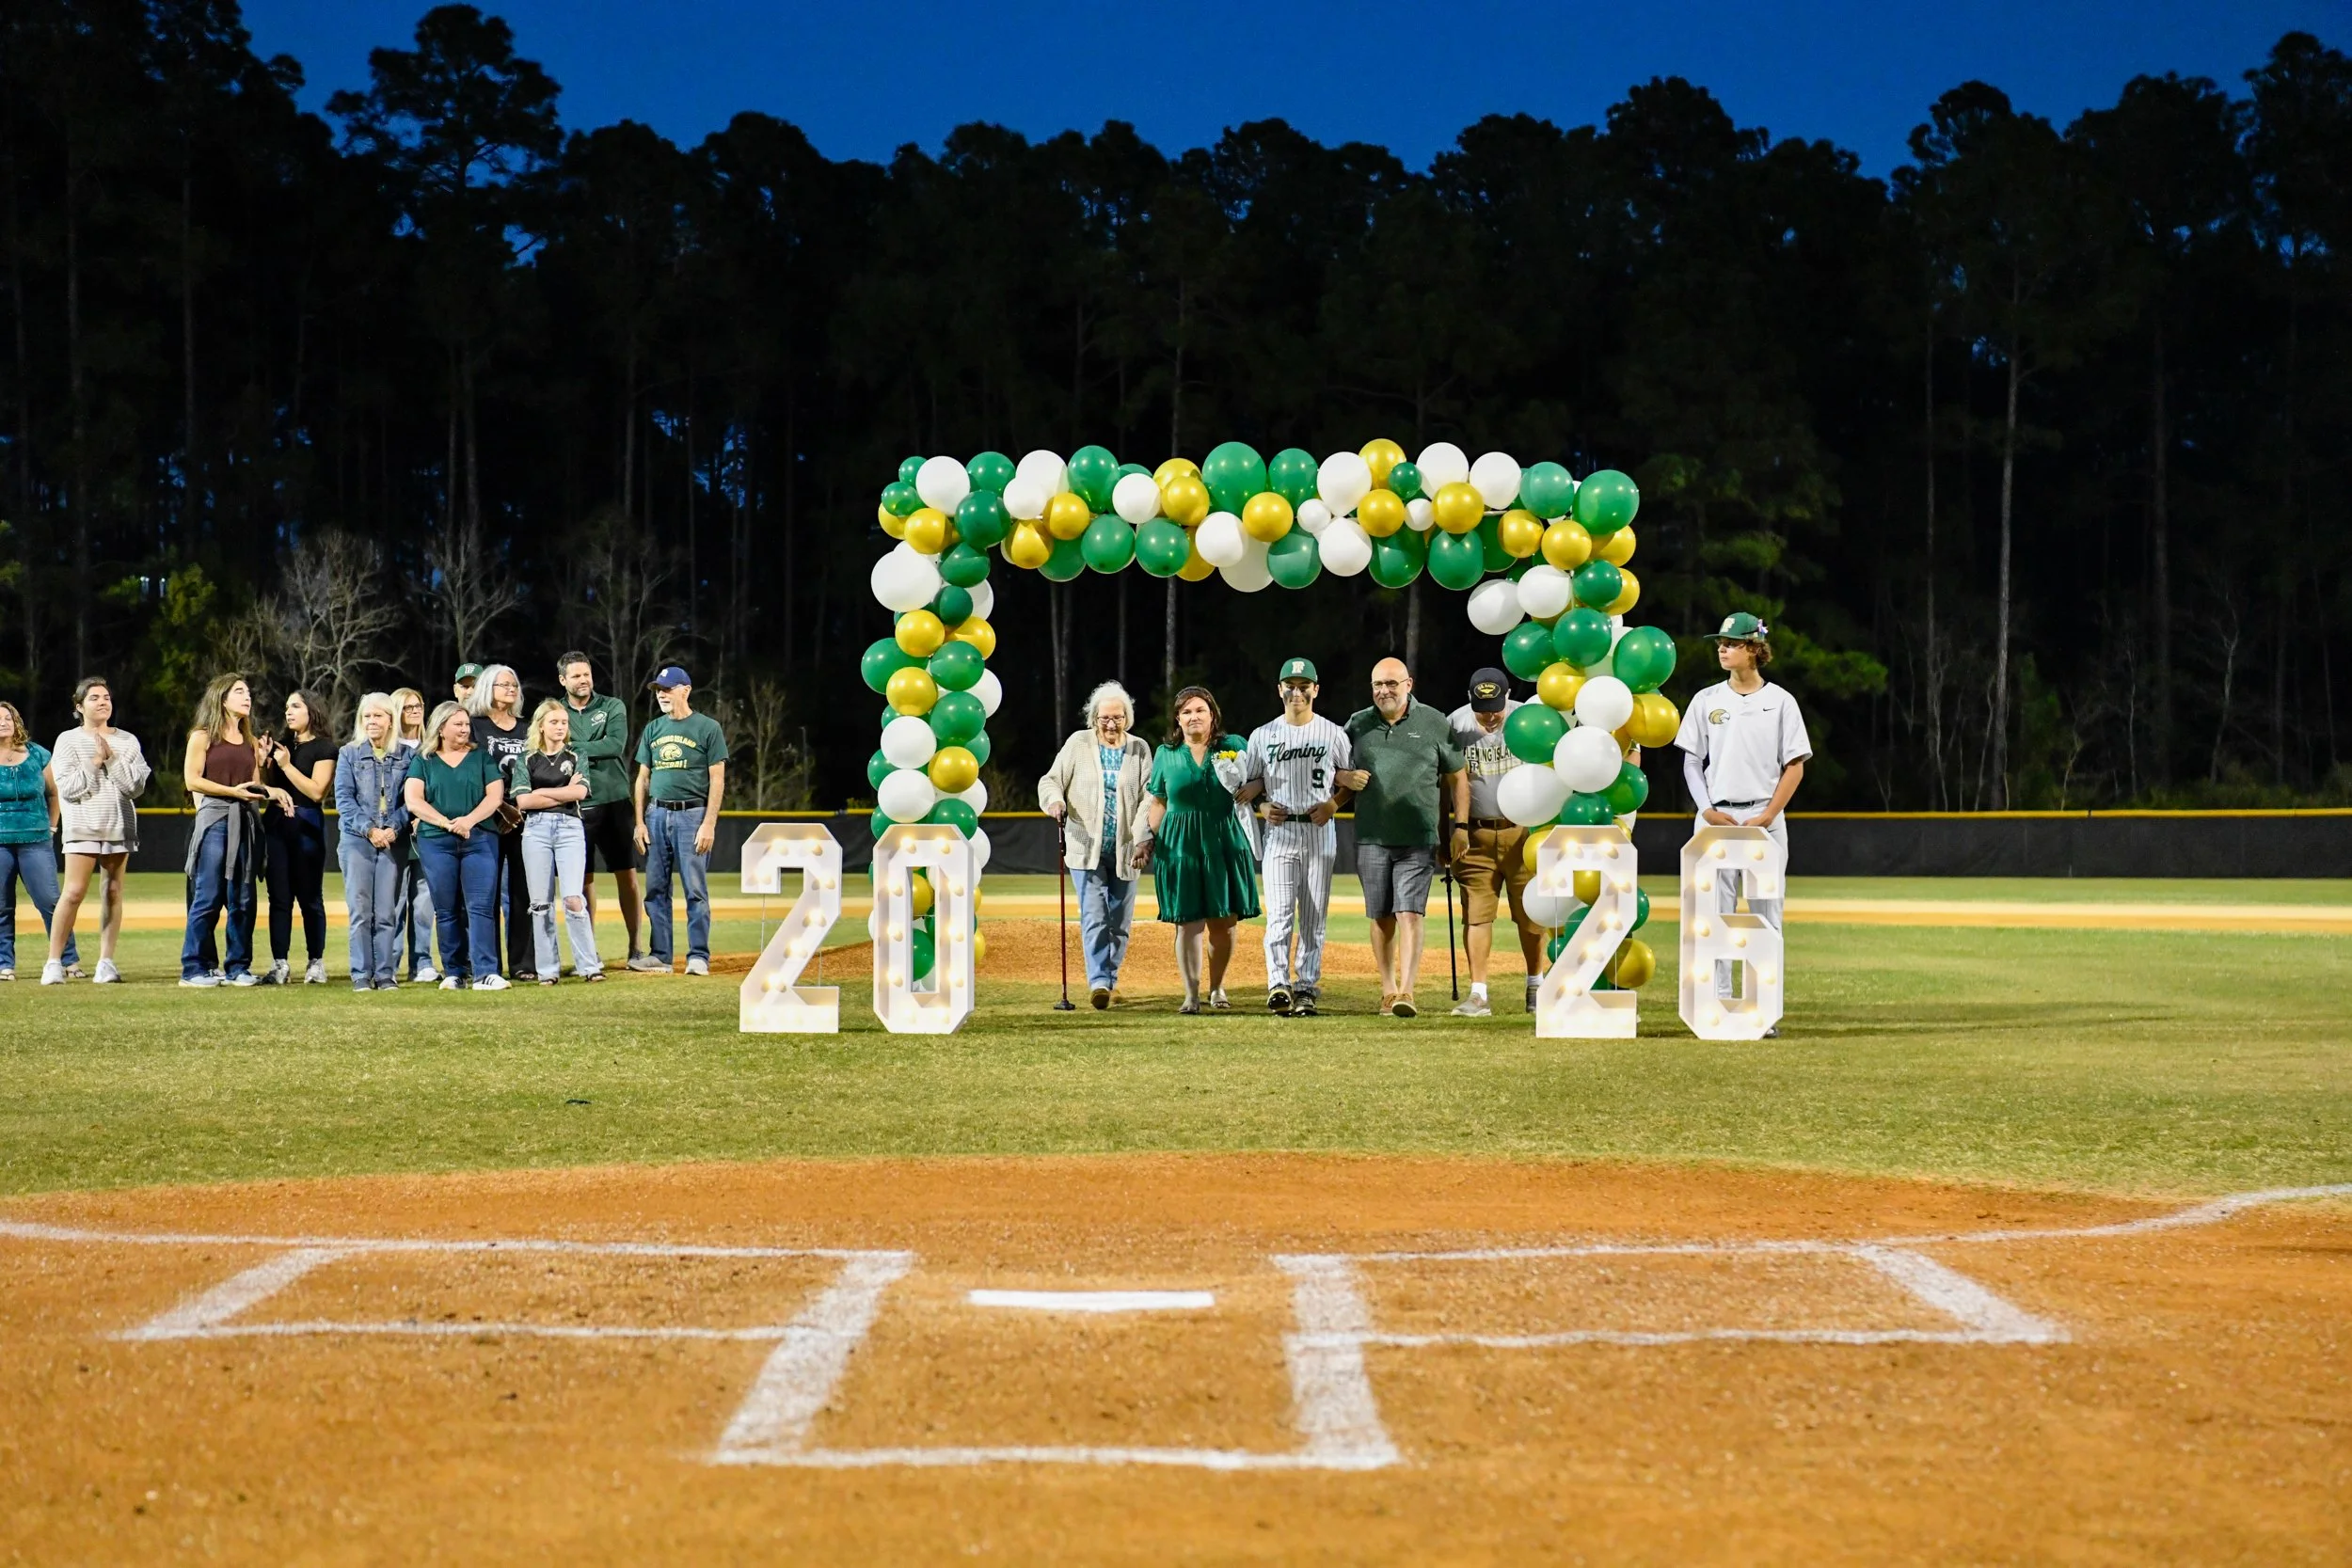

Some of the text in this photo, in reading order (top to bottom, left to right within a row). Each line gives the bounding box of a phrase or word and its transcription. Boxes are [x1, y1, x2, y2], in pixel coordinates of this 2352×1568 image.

[674, 735, 697, 749] ISLAND
[1266, 741, 1327, 764] Fleming
[1311, 768, 1326, 789] 9
